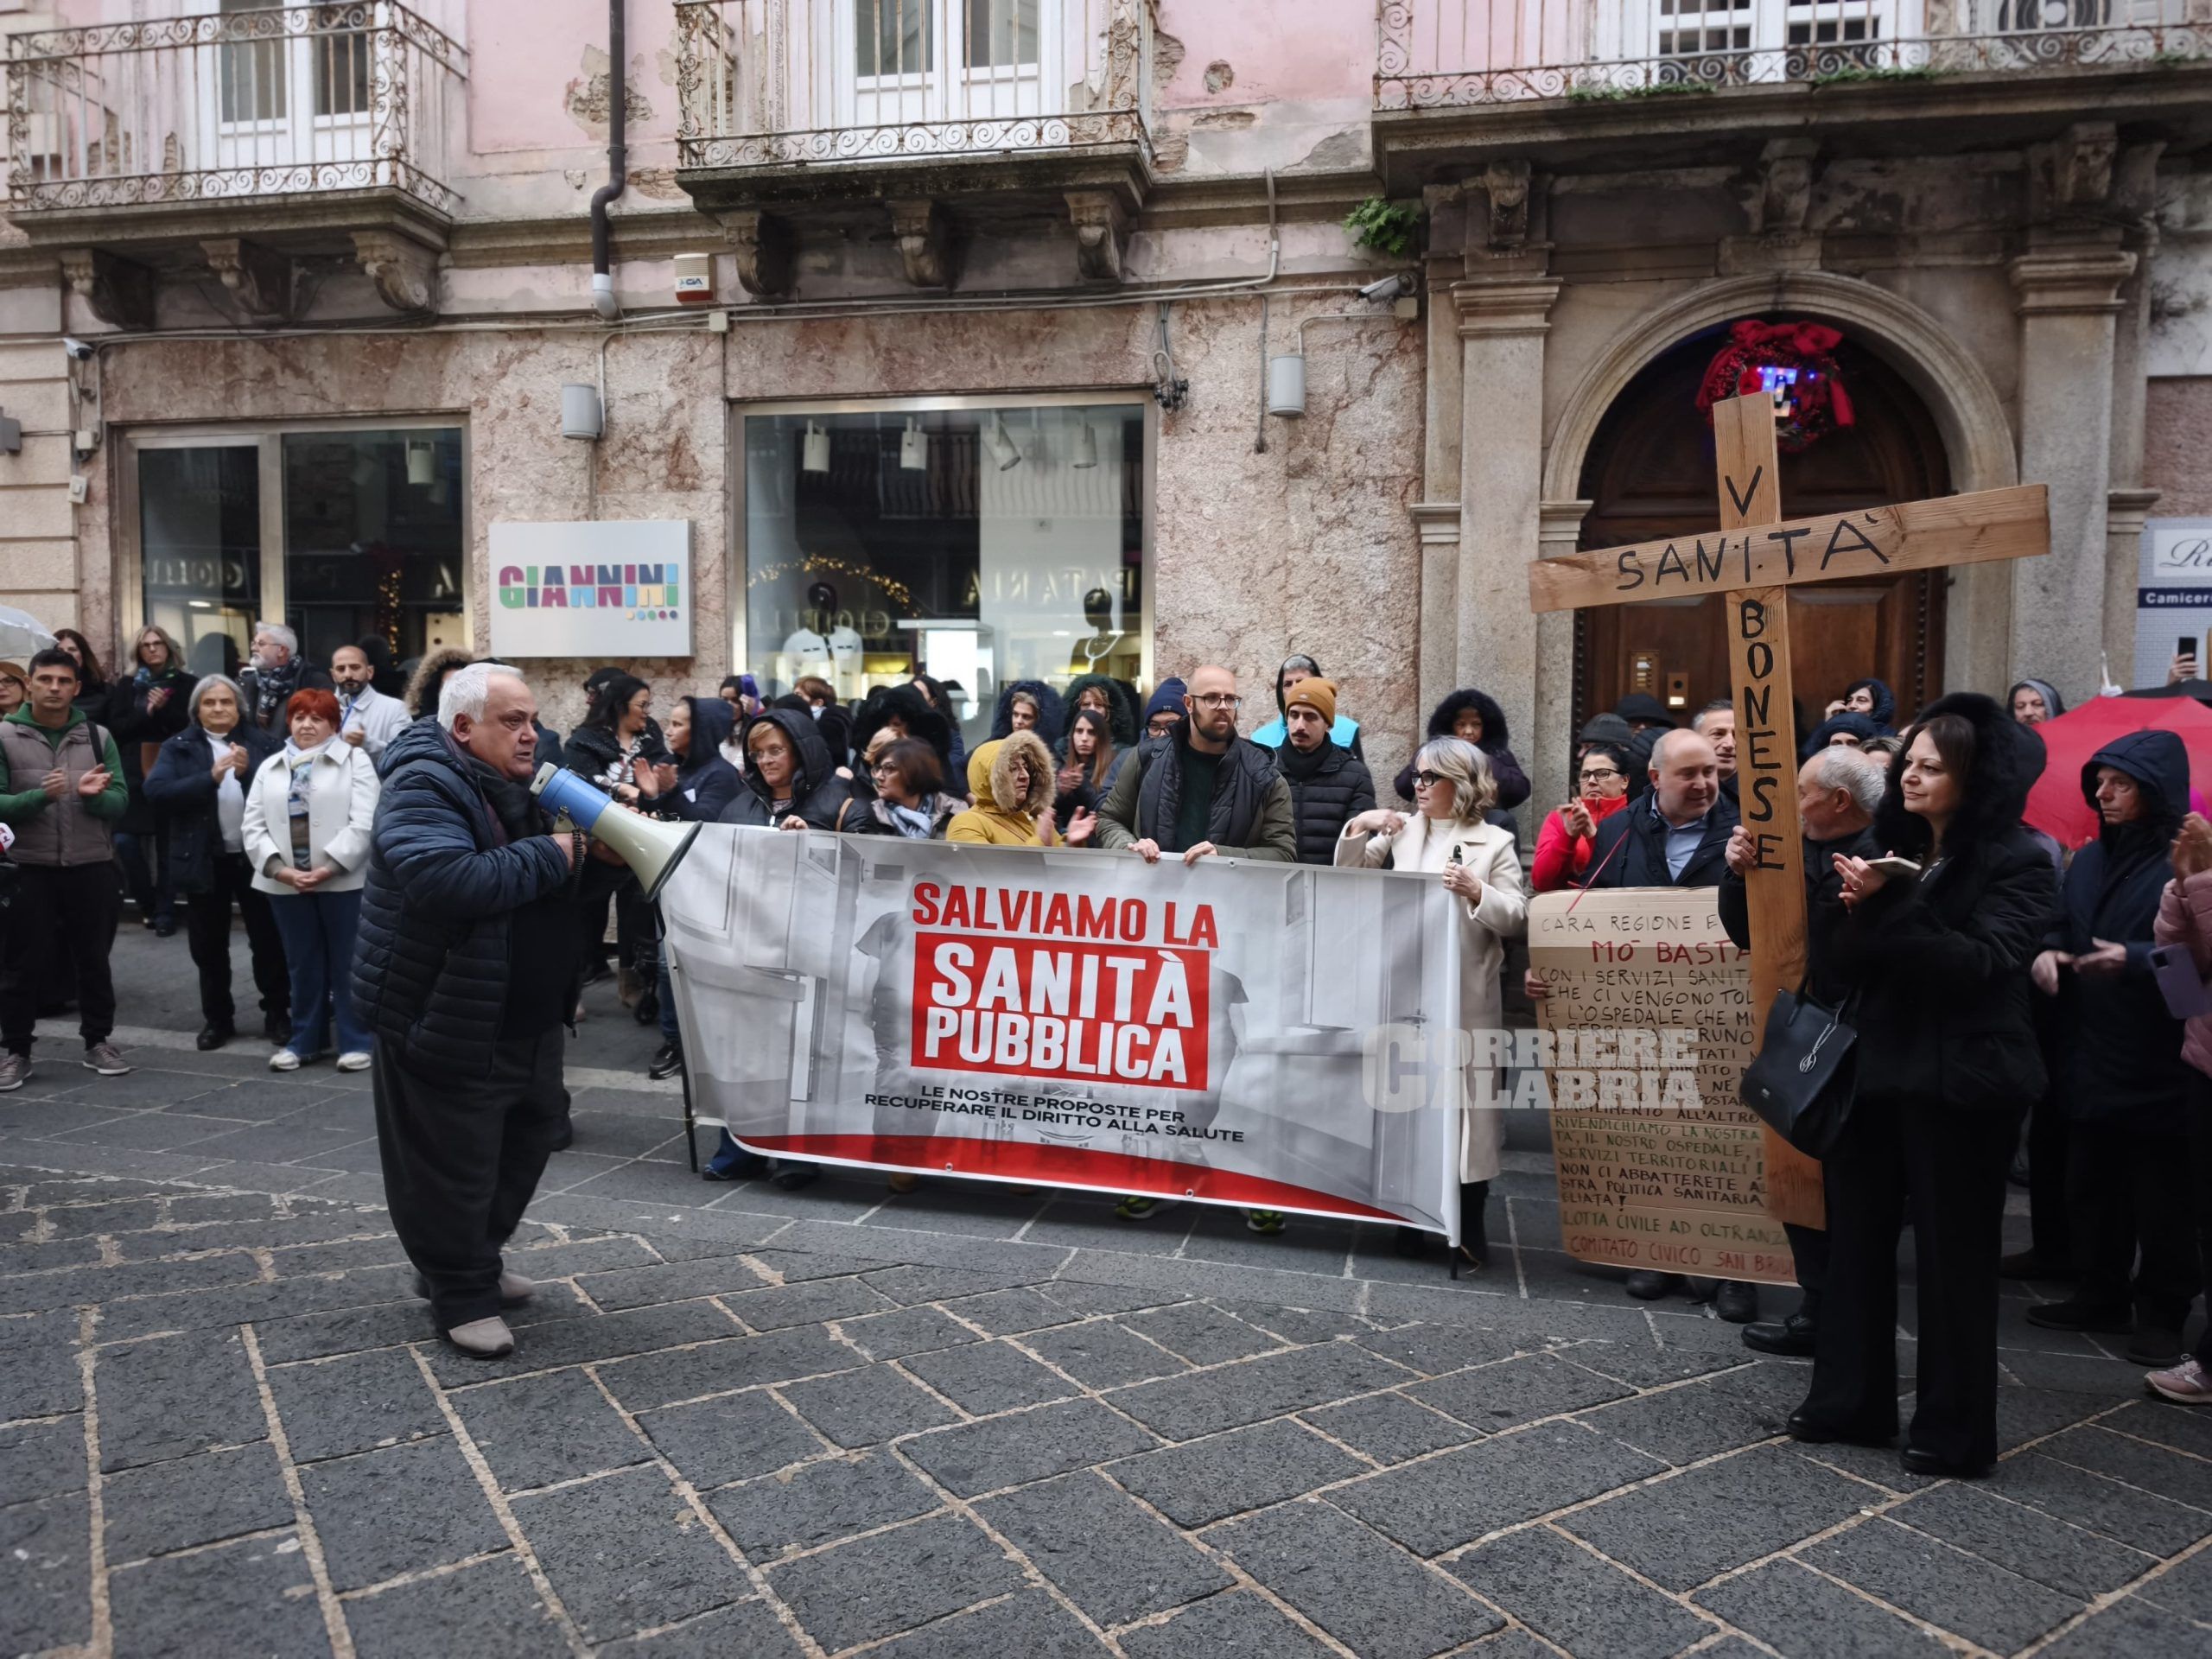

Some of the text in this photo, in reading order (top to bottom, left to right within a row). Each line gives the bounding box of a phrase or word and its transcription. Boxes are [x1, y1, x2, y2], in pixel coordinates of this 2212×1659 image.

[499, 563, 678, 609] GIANNINI
[912, 882, 1219, 949] SALVIAMO LA
[1541, 918, 1597, 932] CARA
[1610, 915, 1691, 931] REGIONE
[931, 941, 1194, 1028] SANITÀ
[1539, 967, 1753, 987] CON I SERVIZI SANIT
[1592, 988, 1611, 1002] CI
[1620, 989, 1714, 1007] VENGONO
[1545, 1003, 1558, 1019] E
[1694, 1009, 1727, 1027] CHE
[924, 1006, 1188, 1084] PUBBLICA
[1566, 1022, 1627, 1040] SERRA
[1637, 1027, 1671, 1044] SAN
[1683, 1027, 1756, 1046] BRUNO
[921, 1084, 1185, 1123] LE NOSTRE PROPOSTE PER
[1676, 1108, 1761, 1123] ALL'ALTRO
[864, 1093, 1245, 1143] RECUPERARE IL DIRITTO ALLA SALUTE
[1555, 1115, 1760, 1141] RIVENDICHIAMO LA NOSTRA
[1585, 1131, 1599, 1145] IL
[1606, 1134, 1656, 1150] NOSTRO
[1558, 1147, 1620, 1163] SERVIZI
[1625, 1151, 1747, 1175] TERRITORIALI
[1560, 1163, 1590, 1177] NON
[1598, 1166, 1611, 1178] CI
[1618, 1167, 1738, 1192] ABBATTERETE
[1560, 1179, 1764, 1208] STRA POLITICA SANITARIA
[1563, 1211, 1609, 1227] LOTTA
[1616, 1213, 1661, 1232] CIVILE
[1669, 1219, 1692, 1235] AD
[1570, 1235, 1638, 1259] COMITATO
[1649, 1242, 1701, 1266] CIVICO
[1713, 1251, 1746, 1272] SAN
